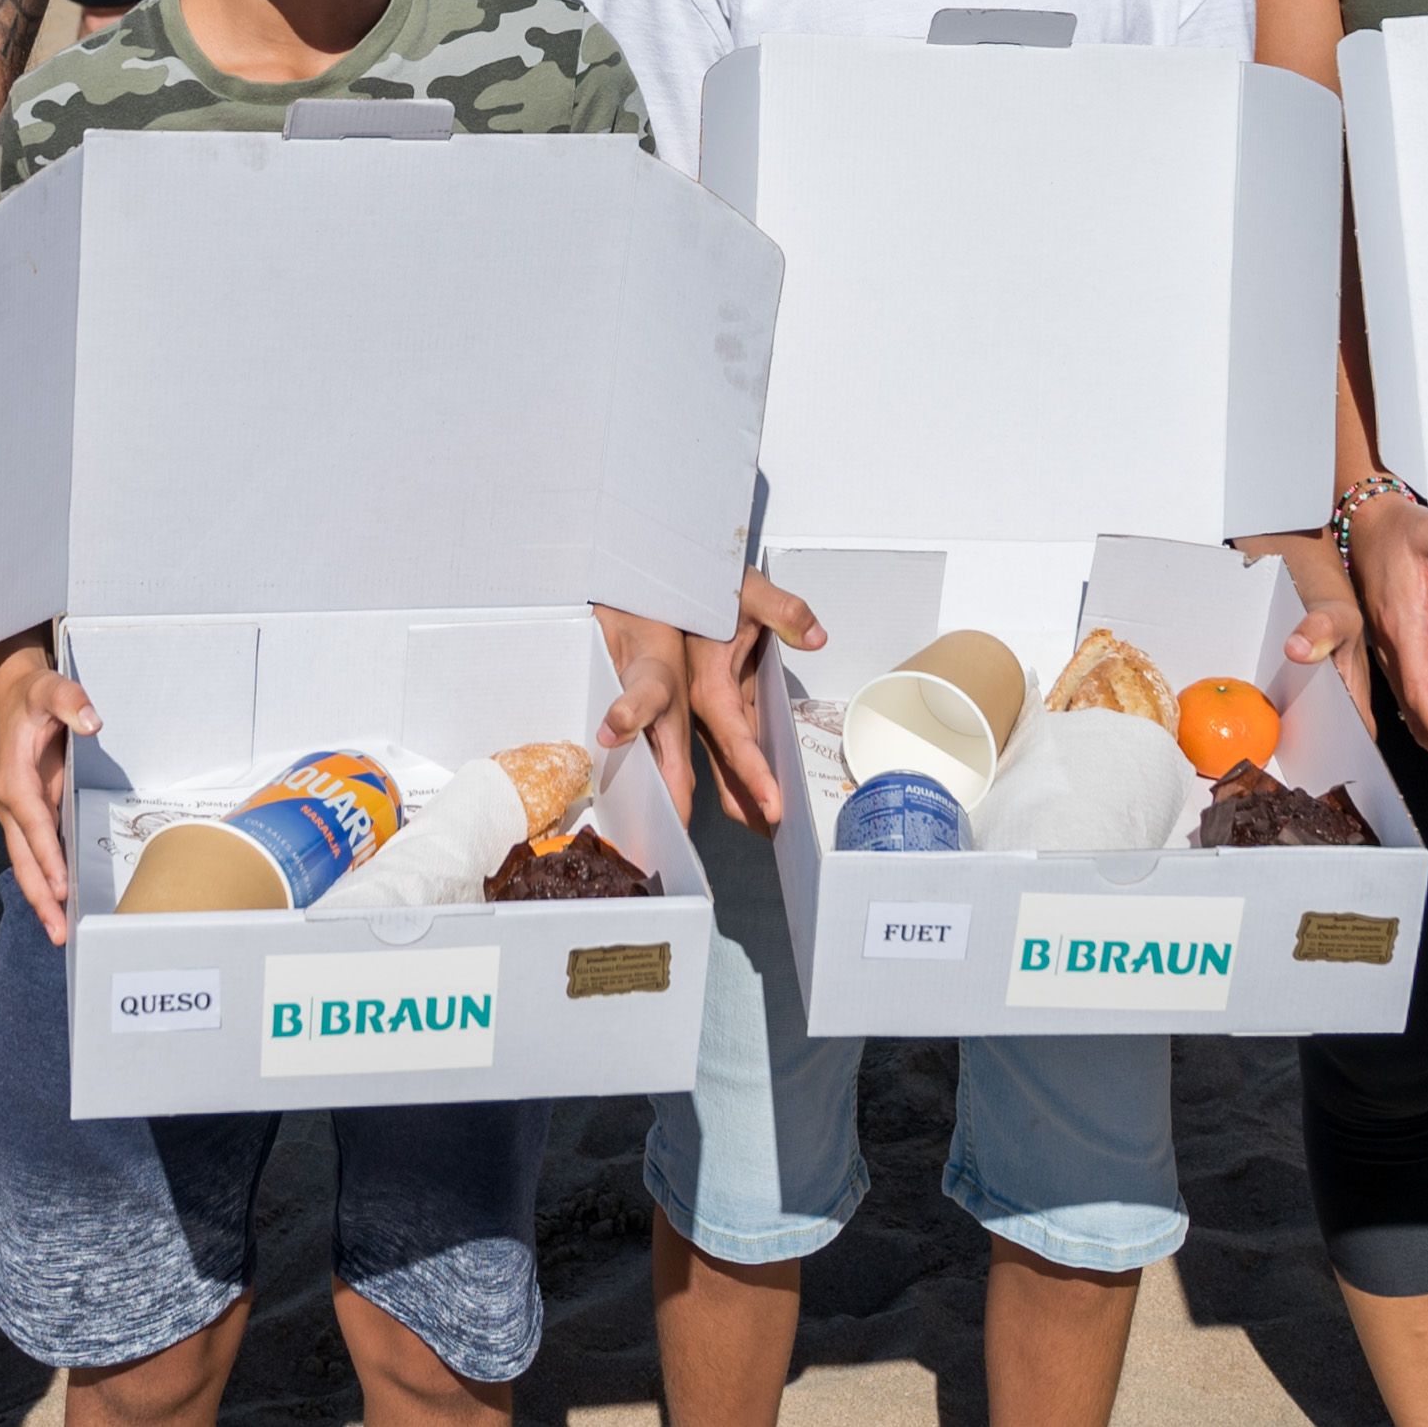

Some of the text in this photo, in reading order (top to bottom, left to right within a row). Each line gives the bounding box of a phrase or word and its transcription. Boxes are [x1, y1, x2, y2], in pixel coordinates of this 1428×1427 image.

[300, 804, 341, 859] NARANJA
[884, 923, 952, 943] FUET
[1021, 938, 1232, 976] B BRAUN
[120, 992, 212, 1016] QUESO
[271, 994, 492, 1038] B BRAUN
